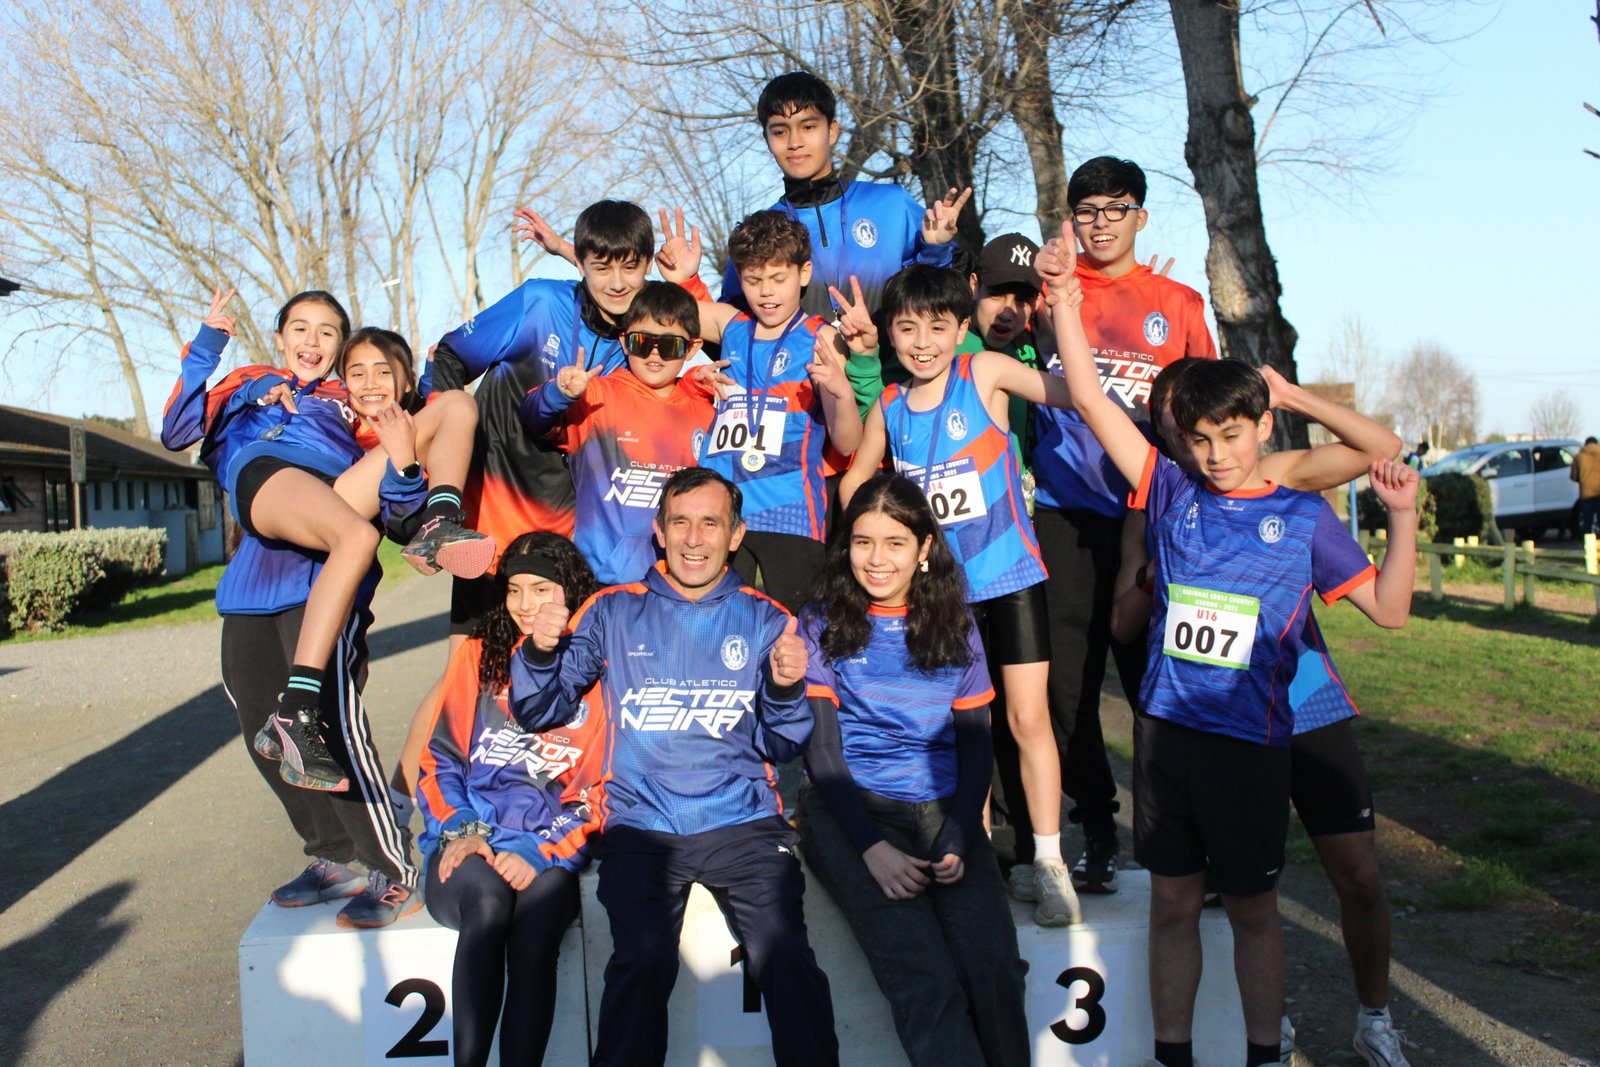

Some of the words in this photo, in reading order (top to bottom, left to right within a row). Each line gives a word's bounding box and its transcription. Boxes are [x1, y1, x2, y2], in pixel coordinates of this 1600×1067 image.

[1010, 244, 1032, 267] NY
[1101, 348, 1155, 362] ATLETICO
[716, 423, 767, 452] 001
[611, 466, 676, 488] HEC
[630, 460, 657, 470] CLUB
[930, 487, 972, 520] 02
[1196, 608, 1218, 622] U16
[1174, 621, 1239, 658] 007
[644, 677, 677, 687] CLUB
[679, 679, 738, 688] ATLETICO
[620, 687, 756, 713] HECTOR
[620, 706, 746, 739] NEIRA
[470, 744, 571, 780] NEIRA
[478, 727, 584, 768] HECTOR
[384, 977, 449, 1059] 2
[1050, 966, 1106, 1045] 3
